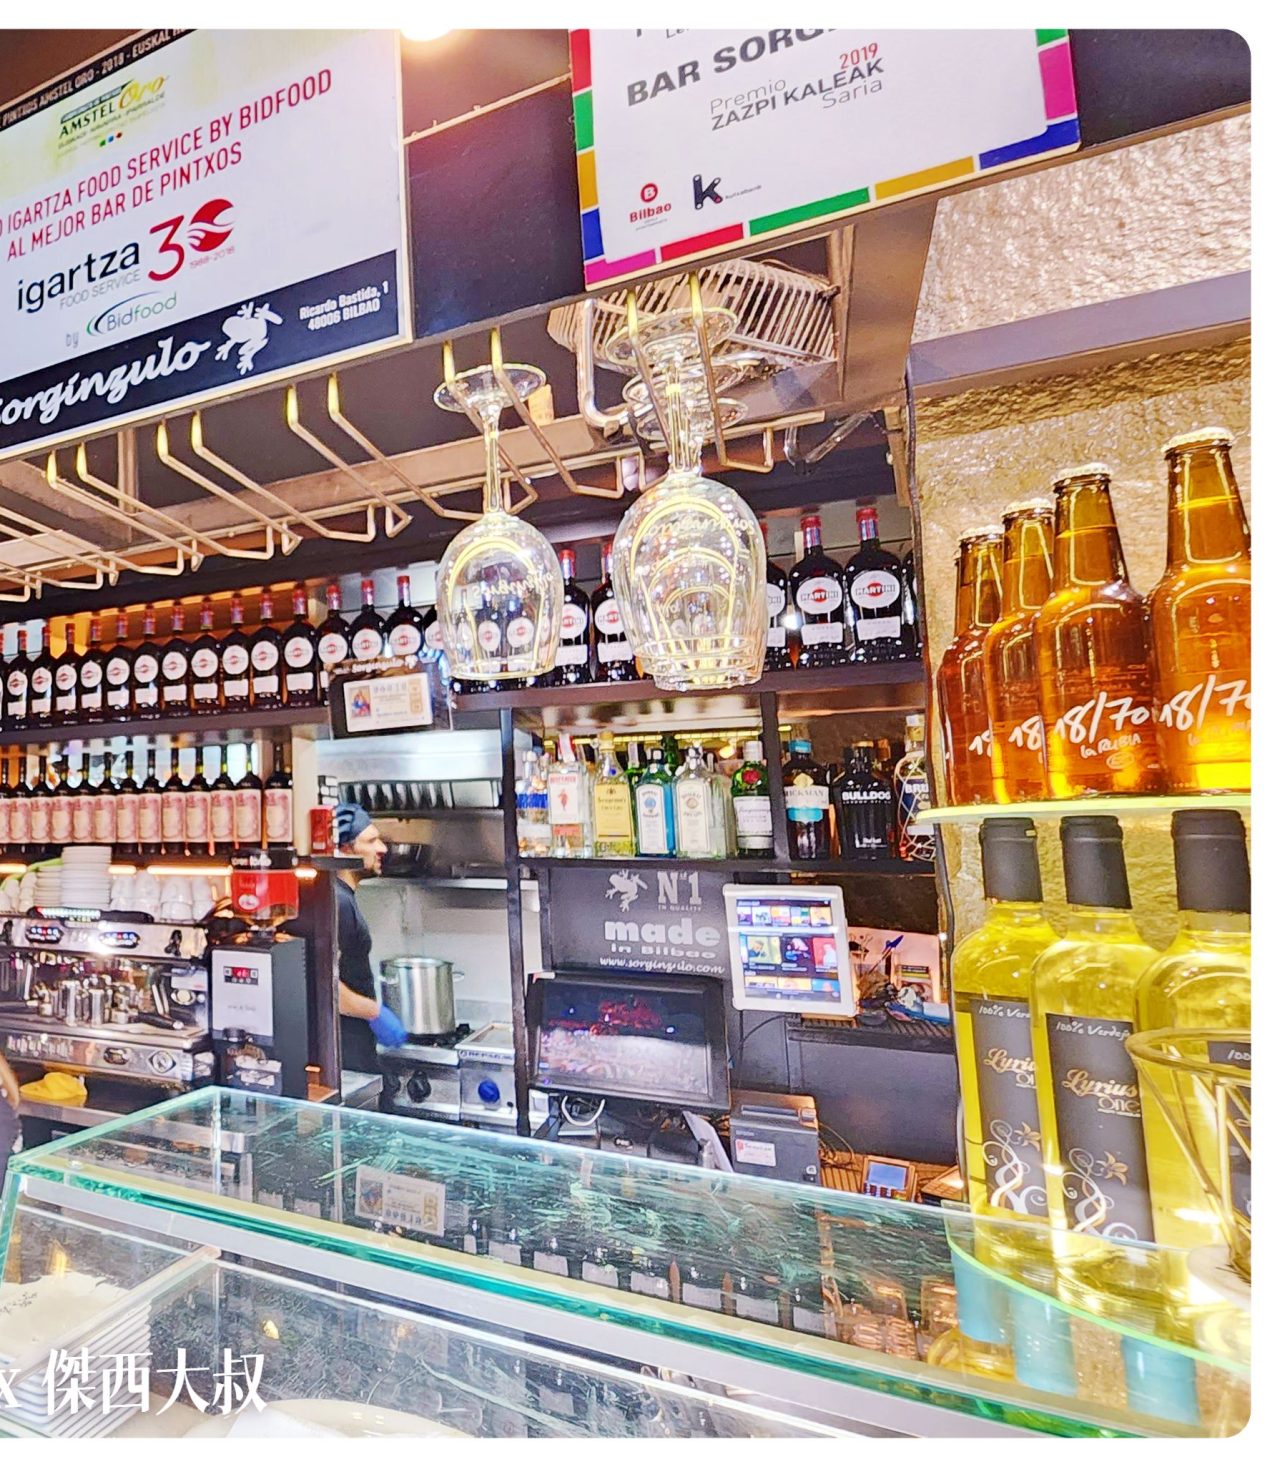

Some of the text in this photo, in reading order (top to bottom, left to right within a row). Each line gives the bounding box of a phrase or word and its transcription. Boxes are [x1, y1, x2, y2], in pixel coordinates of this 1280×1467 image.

[38, 80, 74, 108] AMSTEL
[74, 69, 95, 89] ORO
[132, 29, 172, 59] EUSKAL
[839, 42, 880, 70] 2019
[627, 60, 702, 107] BAR
[710, 78, 788, 115] Premio
[711, 57, 885, 131] ZAZPI KALEAK
[822, 78, 883, 109] Saria
[58, 101, 116, 139] AMSTEL
[7, 188, 74, 239] IGARTZA
[77, 165, 122, 210] FOOD
[126, 131, 204, 181] SERVICE
[207, 112, 234, 153] BY
[238, 68, 333, 131] BIDFOOD
[6, 140, 243, 262] AL MEJOR BAR DE PINTXOS
[629, 202, 673, 223] Bilbao
[16, 240, 141, 315] igartza
[58, 269, 142, 311] FOOD SERVICE
[106, 290, 178, 332] Bidfood
[299, 298, 338, 321] Ricardo
[342, 298, 381, 321] BILBAO
[65, 332, 80, 350] by
[1053, 691, 1151, 744] 18/70
[841, 790, 892, 802] BULLDOG
[604, 917, 721, 947] made
[611, 942, 716, 959] in Bilbao
[1056, 1021, 1084, 1035] 100%
[1062, 1068, 1138, 1098] Lyrius
